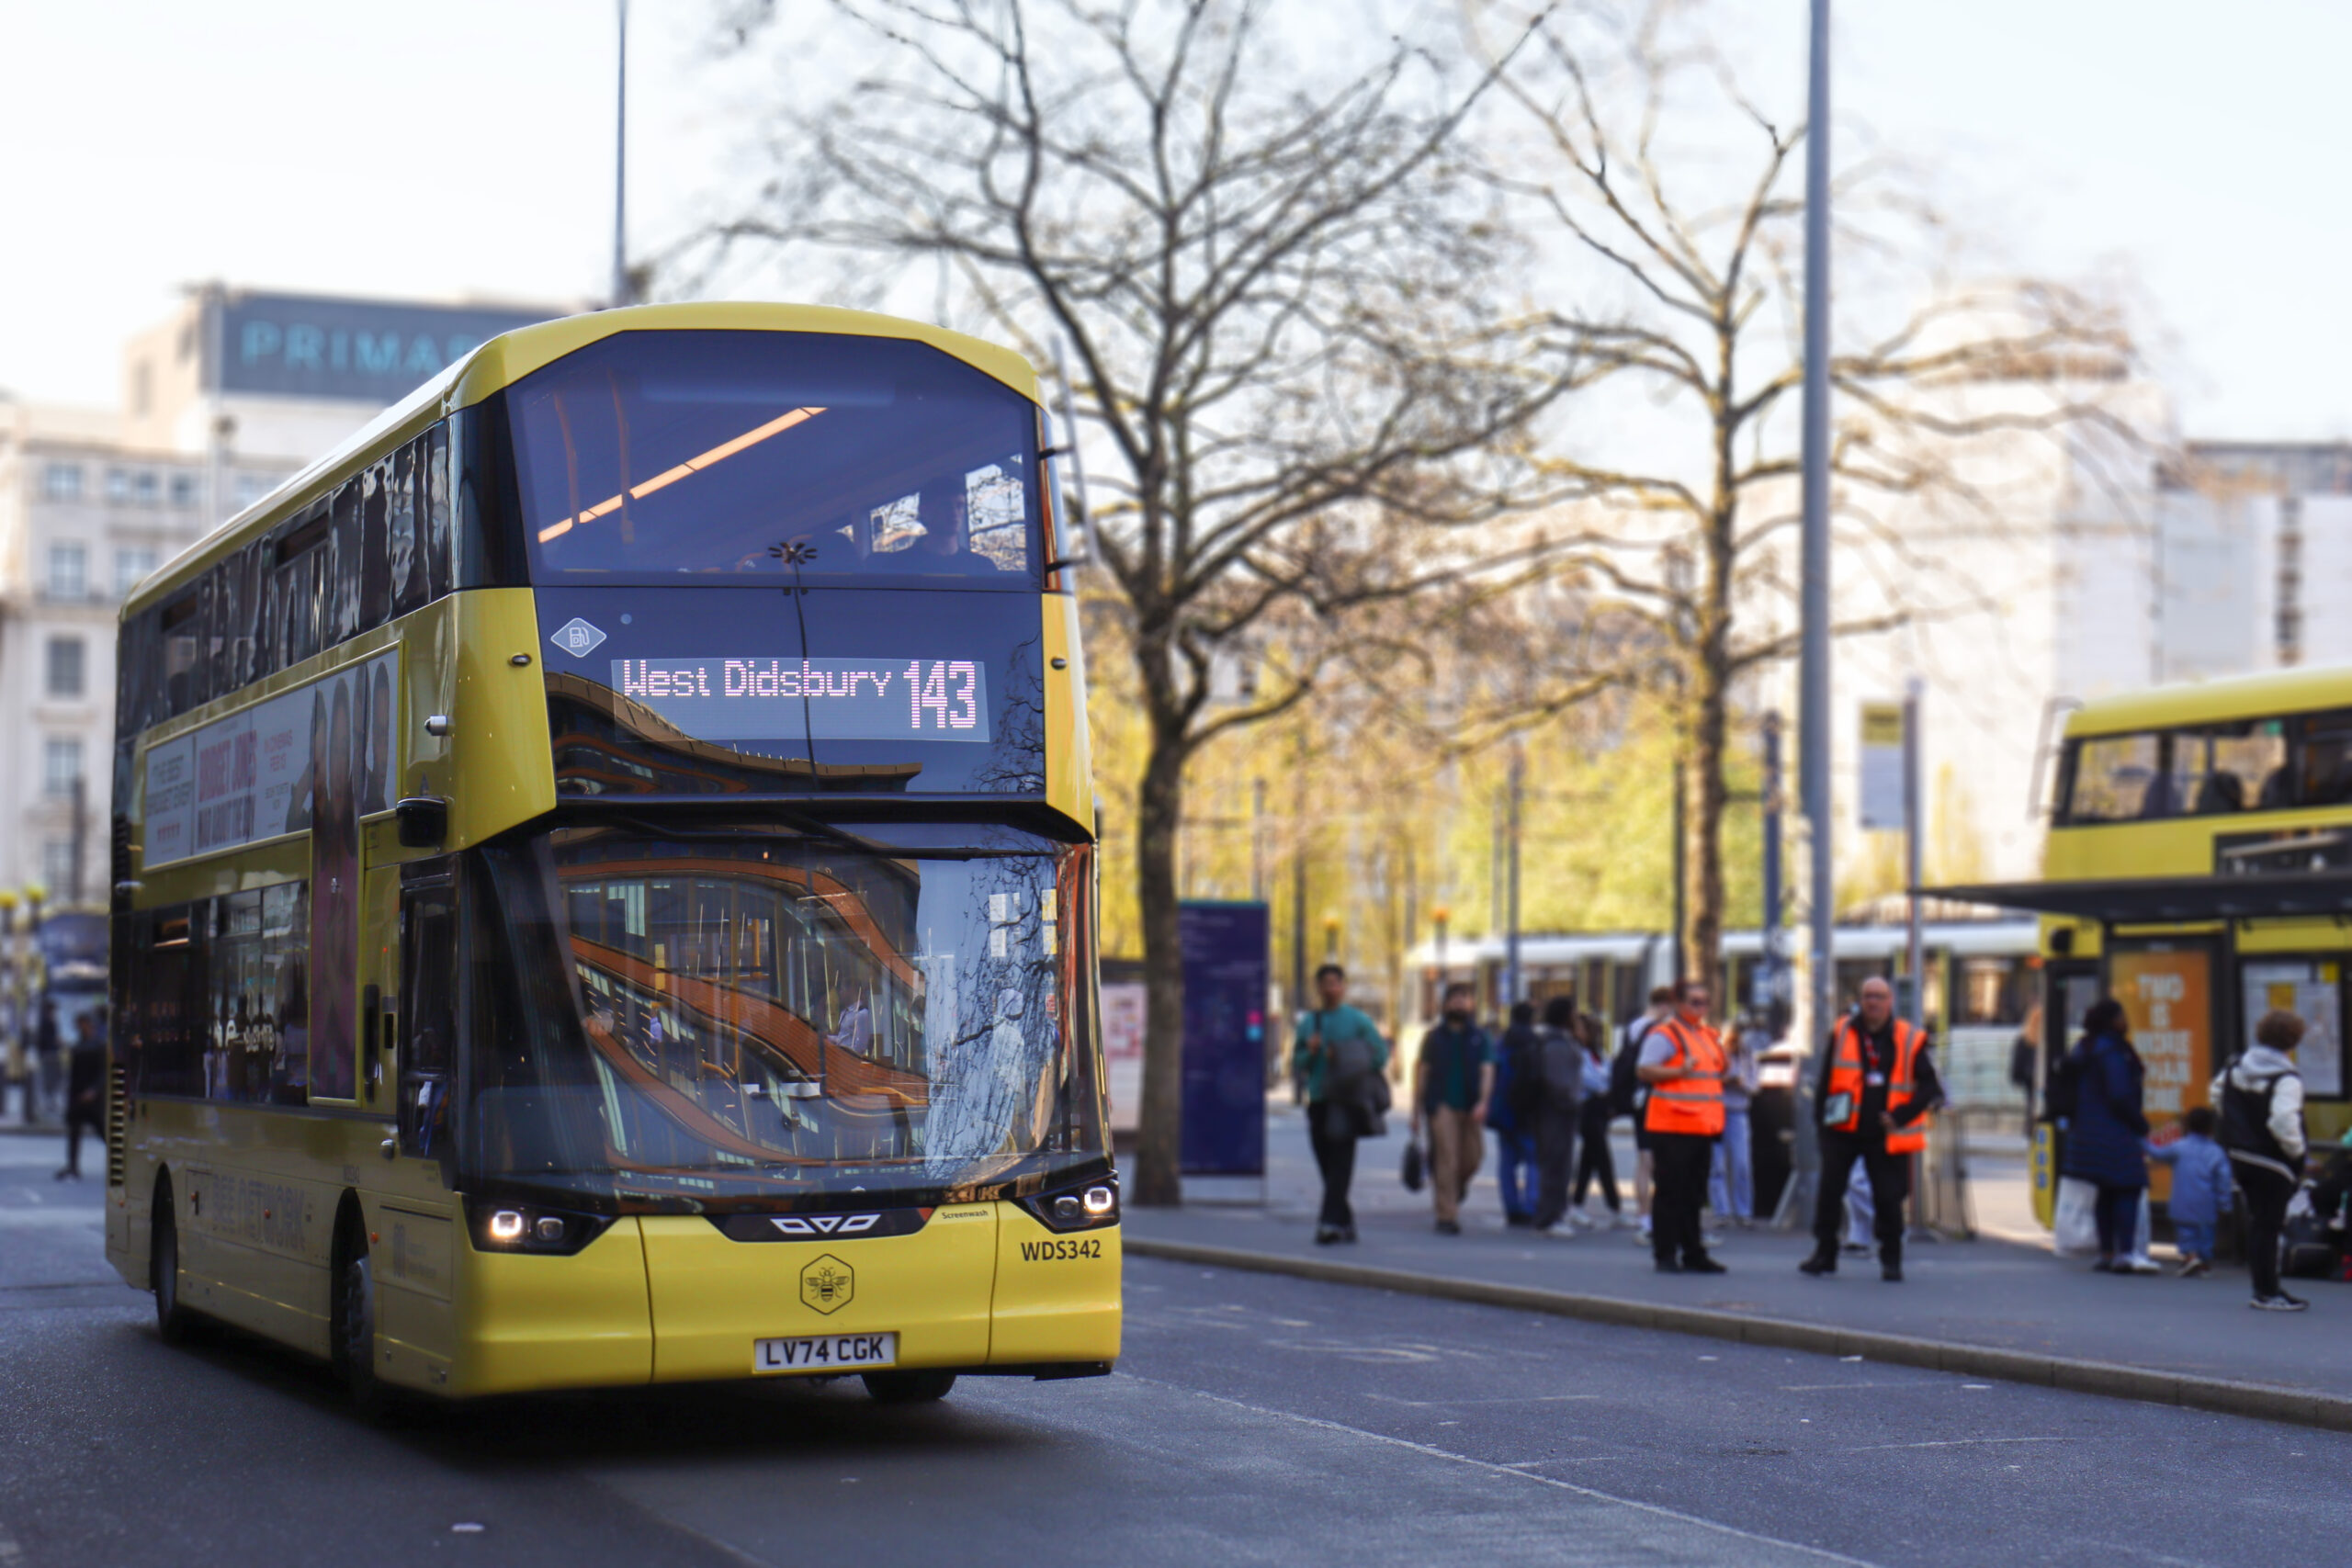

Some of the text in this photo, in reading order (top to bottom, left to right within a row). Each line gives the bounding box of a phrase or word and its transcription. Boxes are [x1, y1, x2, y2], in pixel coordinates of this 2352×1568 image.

[624, 660, 892, 696] West Didsbury
[903, 660, 976, 728] 143
[942, 1209, 989, 1219] Screenwash
[1021, 1240, 1102, 1261] WDS342
[766, 1337, 883, 1365] LV74 CGK
